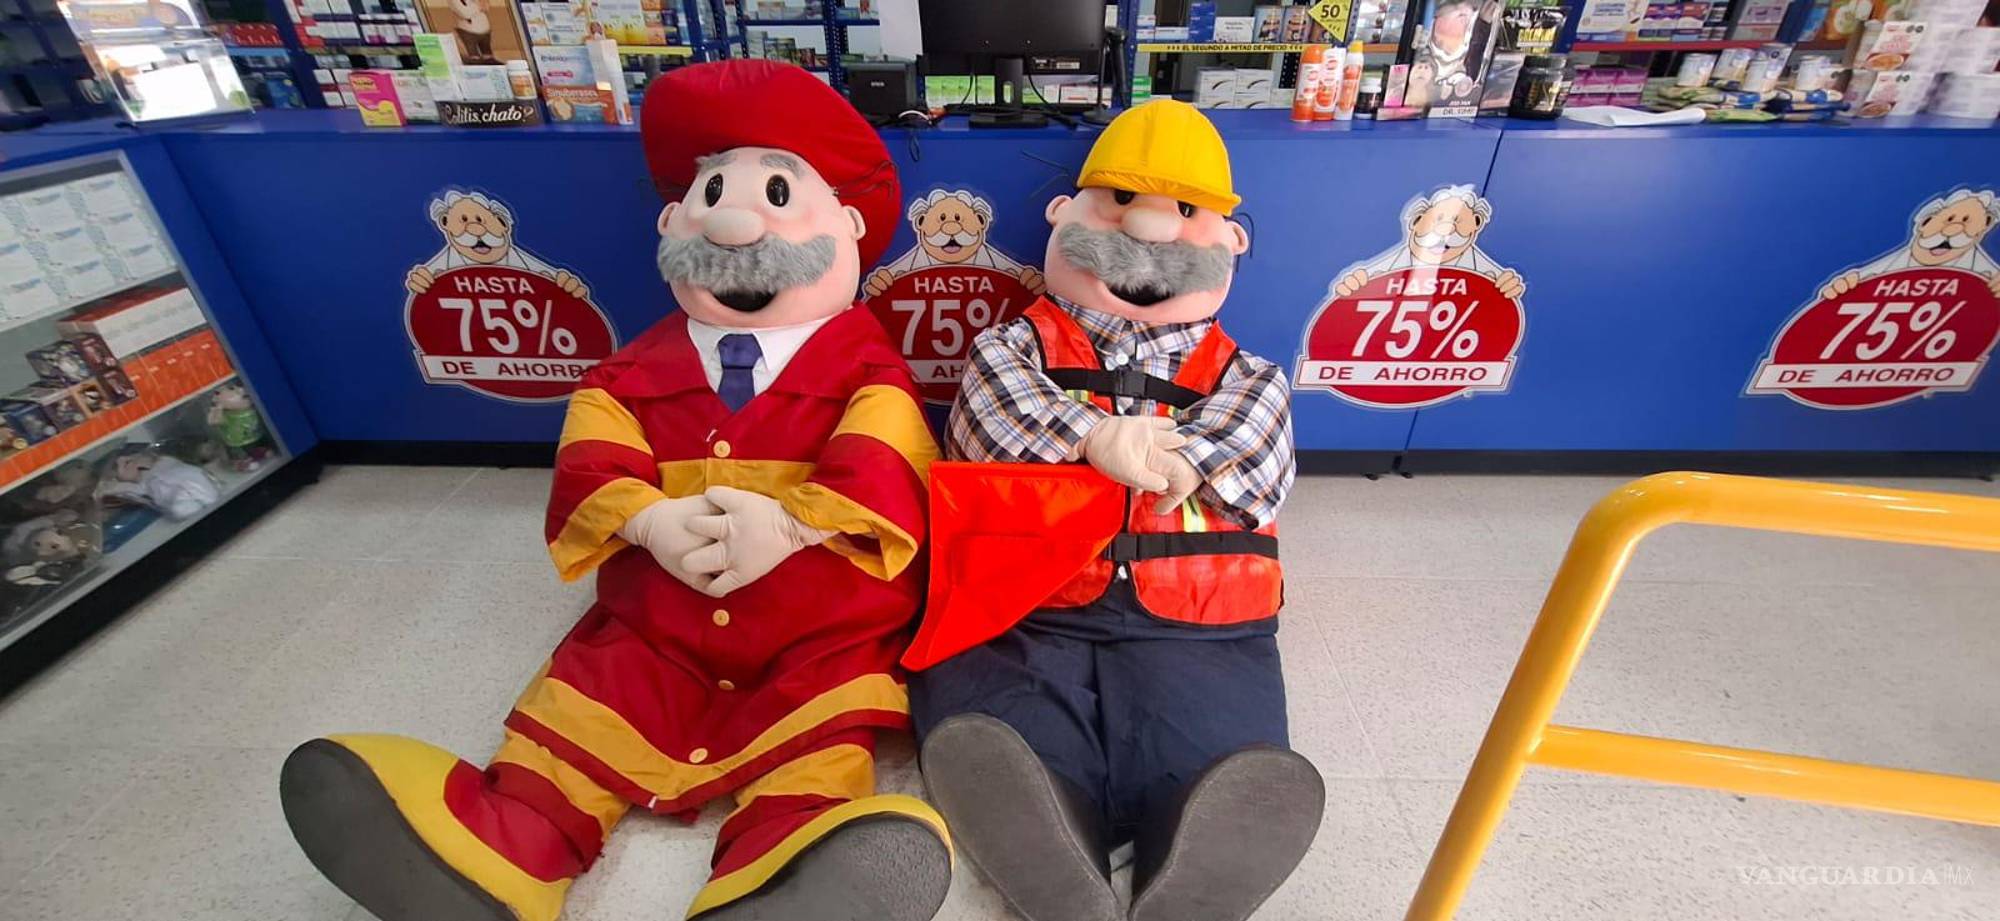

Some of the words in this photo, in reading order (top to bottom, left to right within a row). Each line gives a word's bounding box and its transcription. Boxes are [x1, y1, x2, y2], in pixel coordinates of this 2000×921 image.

[1321, 4, 1341, 18] 50
[454, 276, 535, 294] HASTA
[914, 276, 994, 294] HASTA
[1386, 278, 1467, 296] HASTA
[1873, 278, 1959, 297] HASTA
[438, 298, 577, 355] 75%
[1351, 300, 1480, 359] 75%
[1819, 301, 1967, 361] 75%
[442, 361, 477, 375] DE
[1318, 366, 1354, 380] DE
[1374, 367, 1487, 381] AHORRO
[1777, 370, 1816, 384] DE
[1835, 368, 1955, 383] AHORRO
